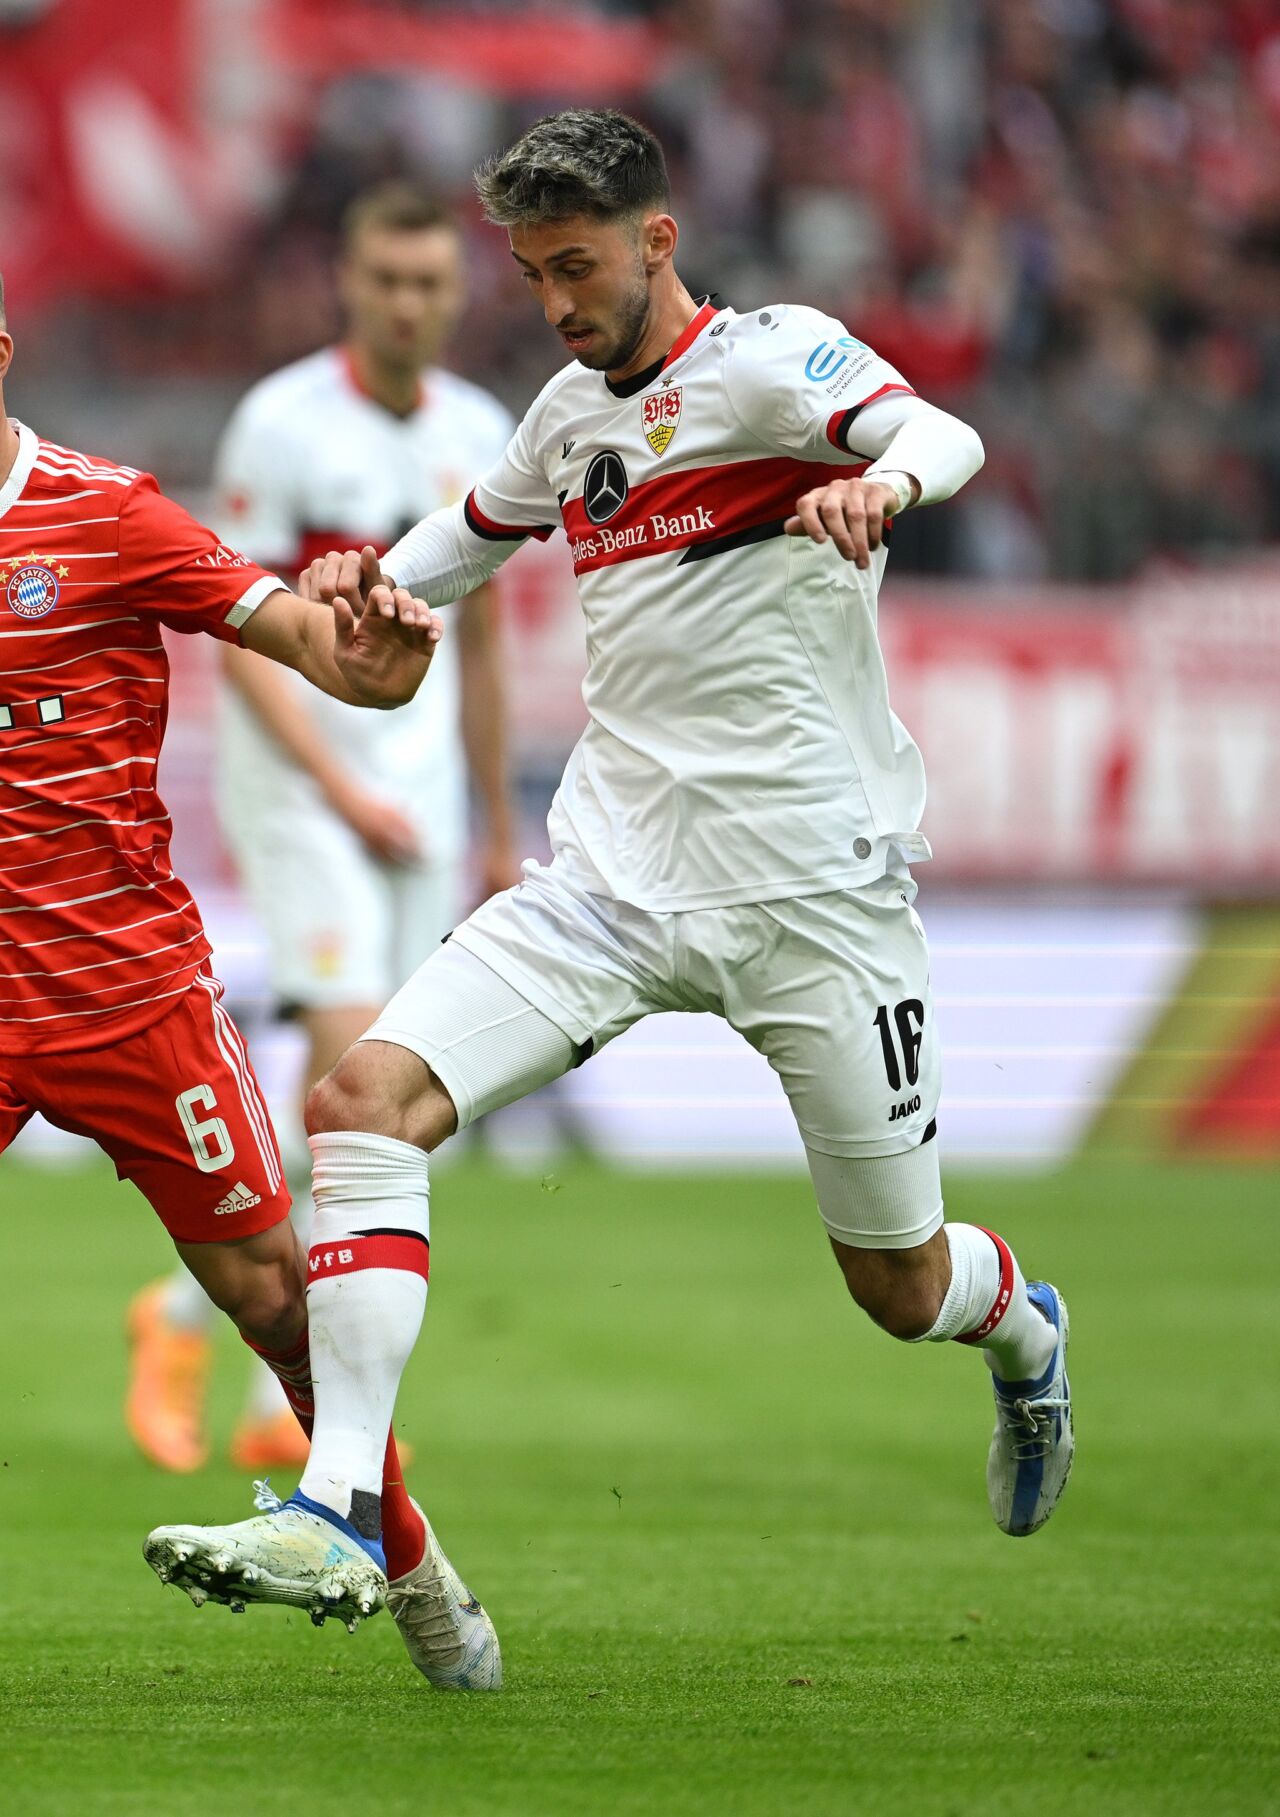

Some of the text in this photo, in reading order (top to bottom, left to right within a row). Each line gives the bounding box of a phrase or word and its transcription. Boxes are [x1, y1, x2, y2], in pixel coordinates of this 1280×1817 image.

[650, 506, 716, 541] Bank
[11, 569, 54, 591] FC BAYERN
[11, 595, 54, 615] MÜNCHEN
[872, 998, 925, 1092] 16
[888, 1094, 922, 1122] JAKO
[175, 1083, 235, 1173] 6
[213, 1193, 262, 1215] adidas
[308, 1248, 354, 1272] VfB
